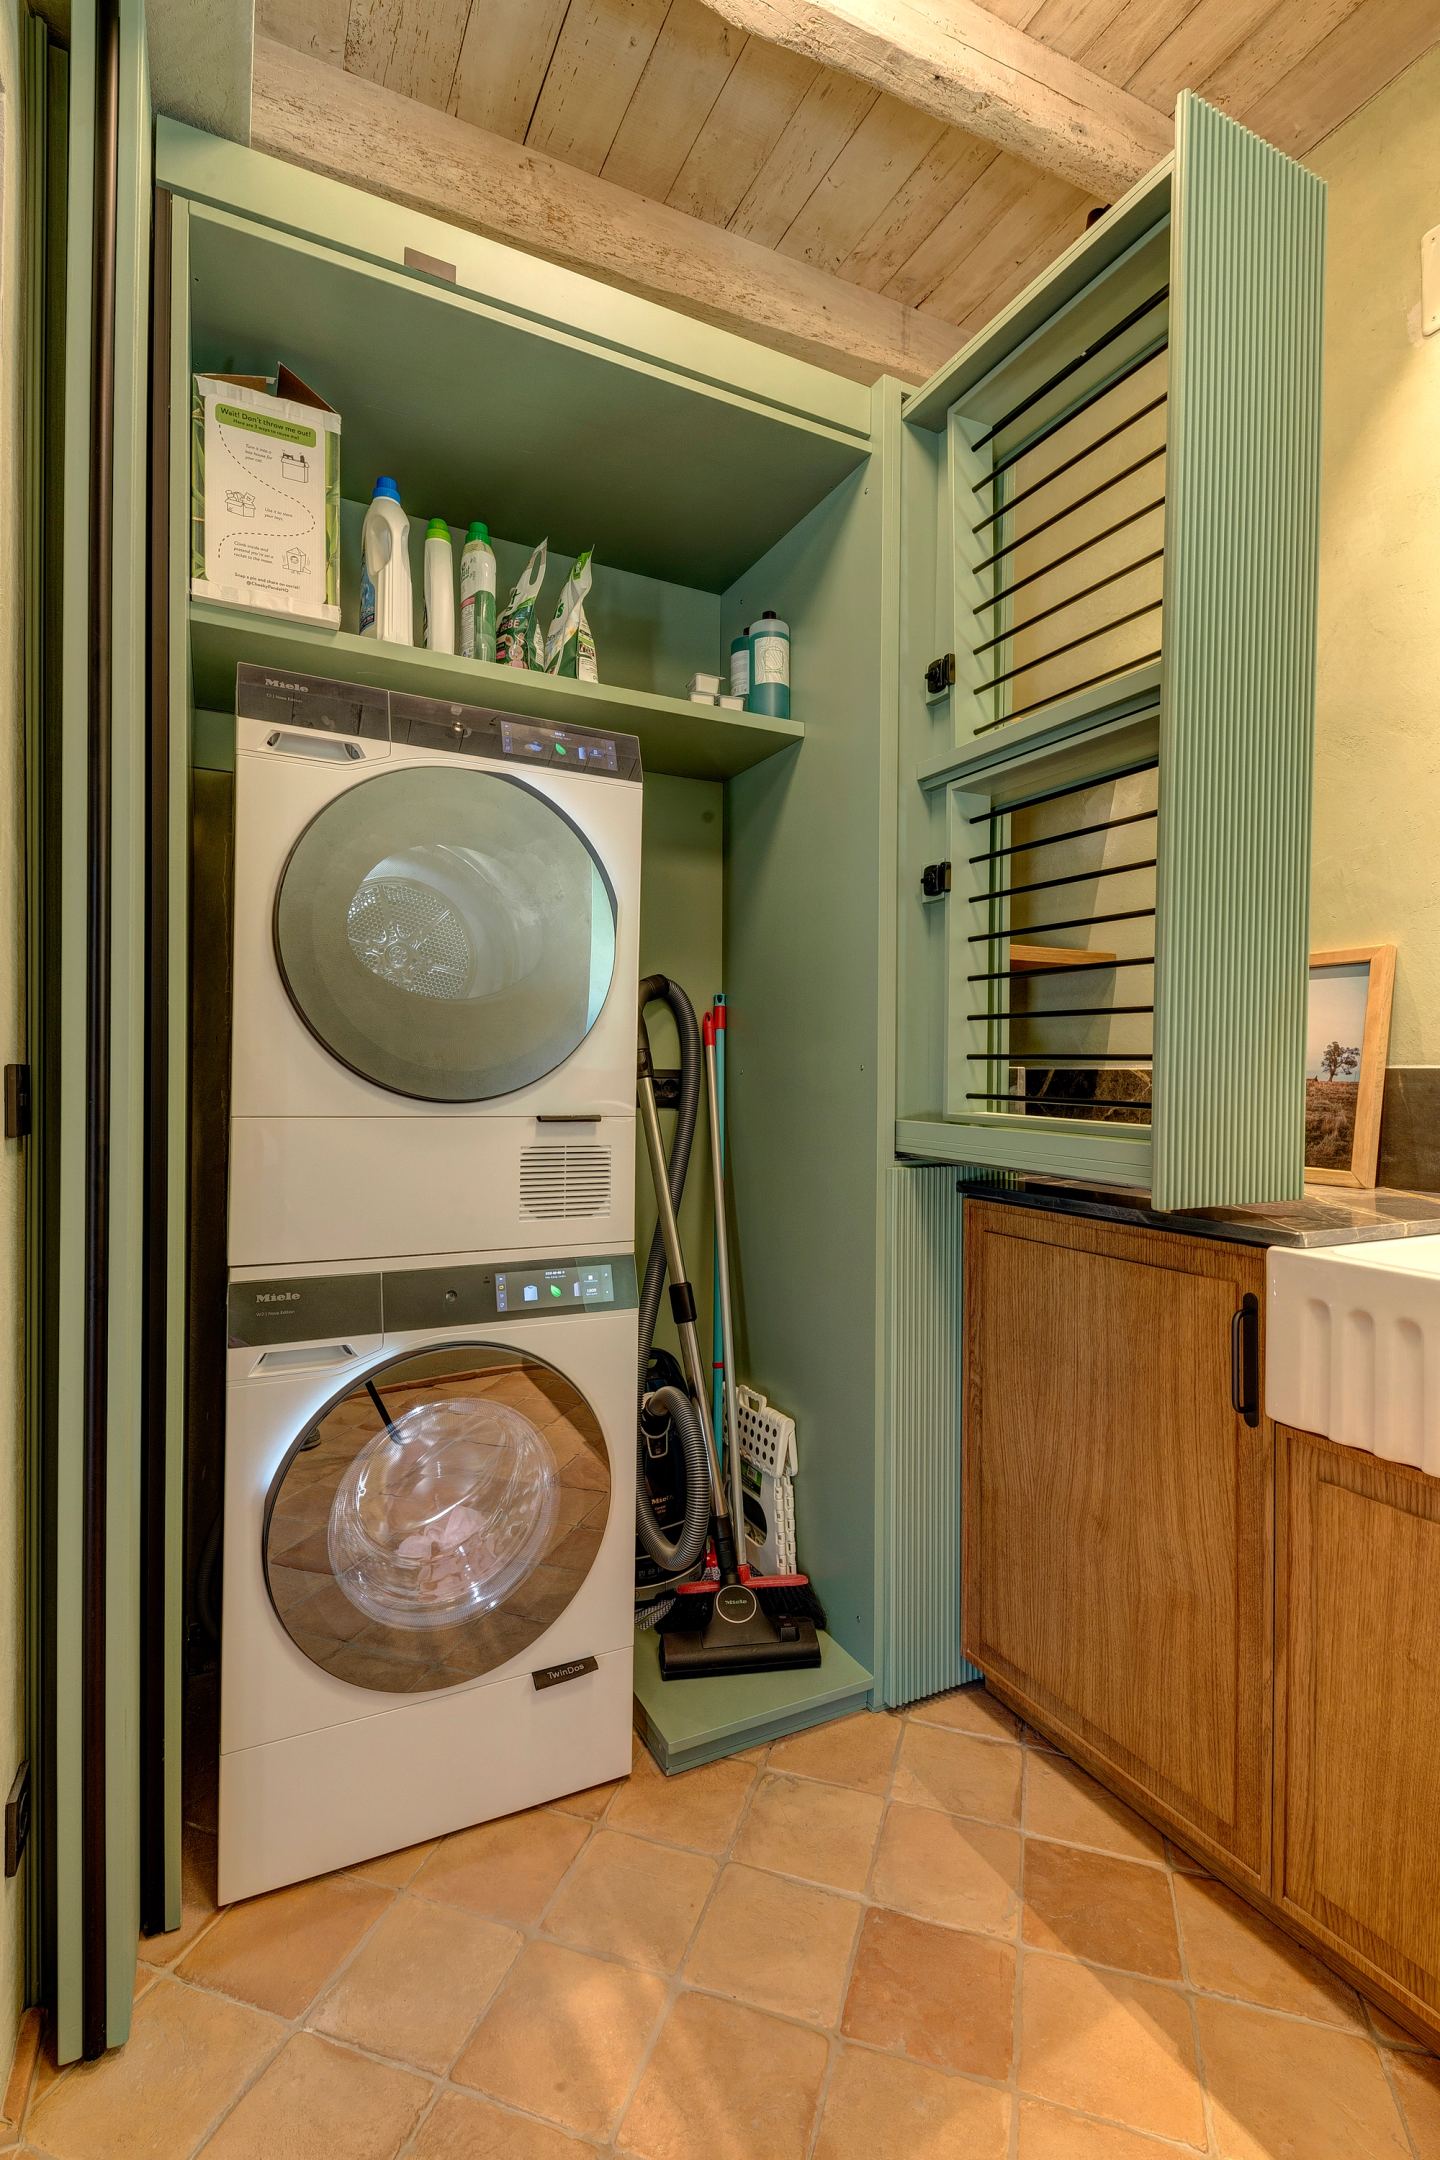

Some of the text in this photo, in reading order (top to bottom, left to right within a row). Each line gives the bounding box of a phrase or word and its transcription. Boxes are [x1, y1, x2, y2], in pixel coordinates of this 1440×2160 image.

[220, 407, 311, 438] Wait! Don't throw me out!
[265, 678, 308, 692] Miele
[256, 1292, 300, 1302] Miele
[546, 1664, 584, 1680] TwinDos
